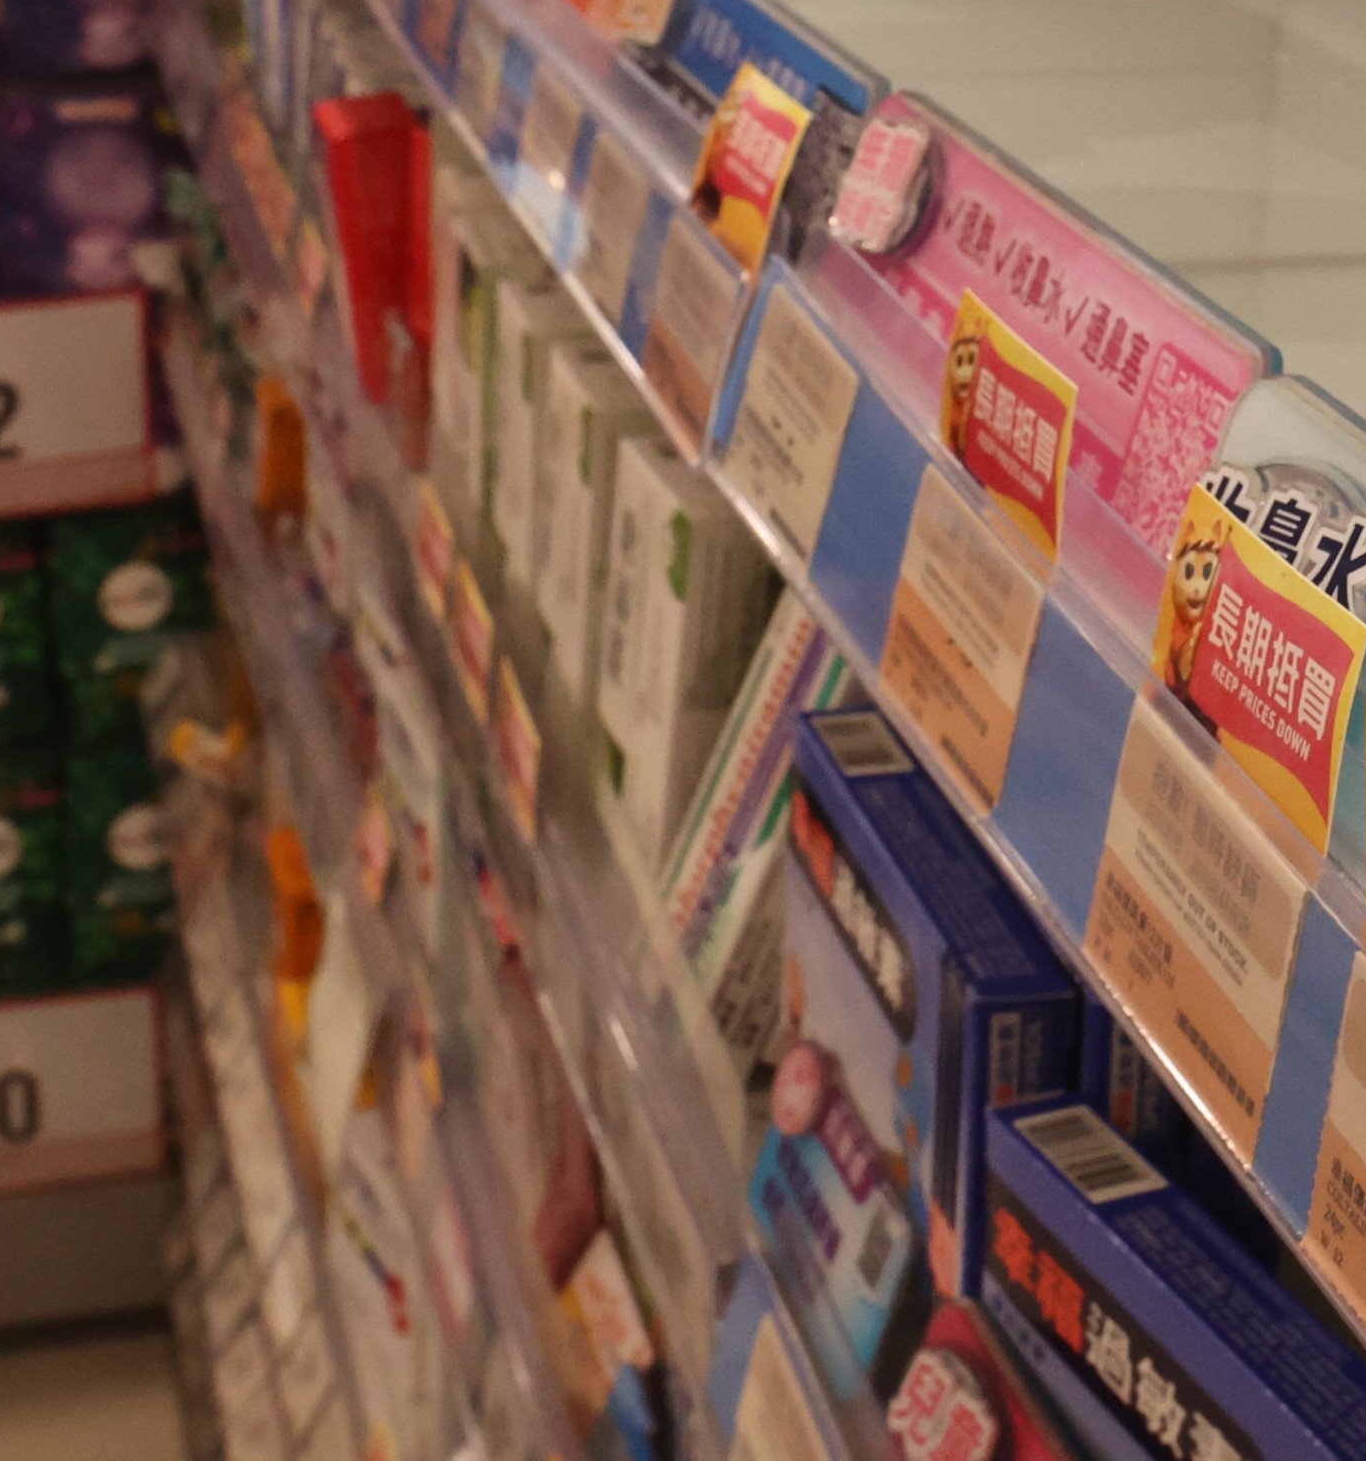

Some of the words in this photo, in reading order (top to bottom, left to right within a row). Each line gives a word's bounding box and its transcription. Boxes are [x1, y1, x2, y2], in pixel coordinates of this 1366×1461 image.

[1207, 582, 1337, 741] 長期抵買
[1211, 659, 1241, 693] KEEP
[1238, 684, 1277, 731] PRICES
[1276, 718, 1312, 762] DOWN
